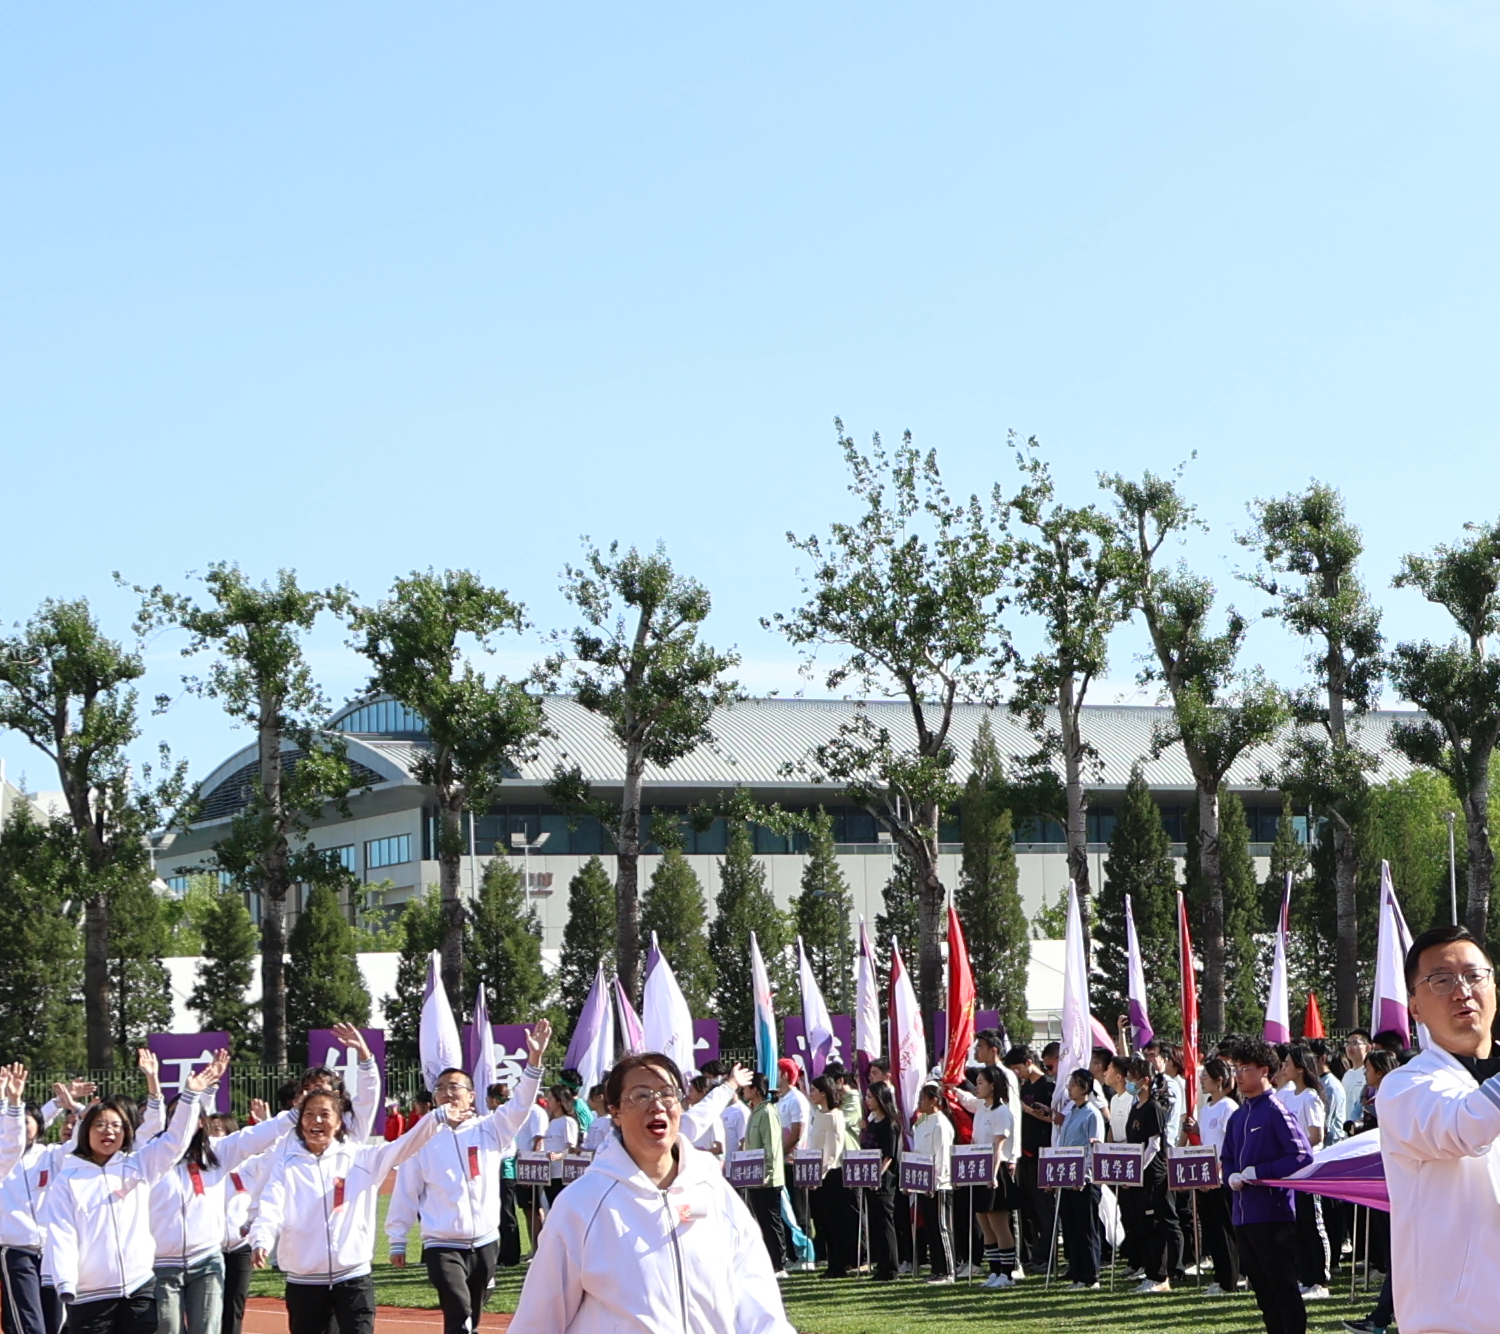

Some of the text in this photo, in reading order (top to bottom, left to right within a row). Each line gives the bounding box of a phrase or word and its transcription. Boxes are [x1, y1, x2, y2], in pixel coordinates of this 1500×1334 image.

[957, 1158, 986, 1180] 地学系
[1045, 1161, 1078, 1183] 化学系
[1100, 1158, 1135, 1180] 数学系
[1175, 1161, 1211, 1184] 化工系
